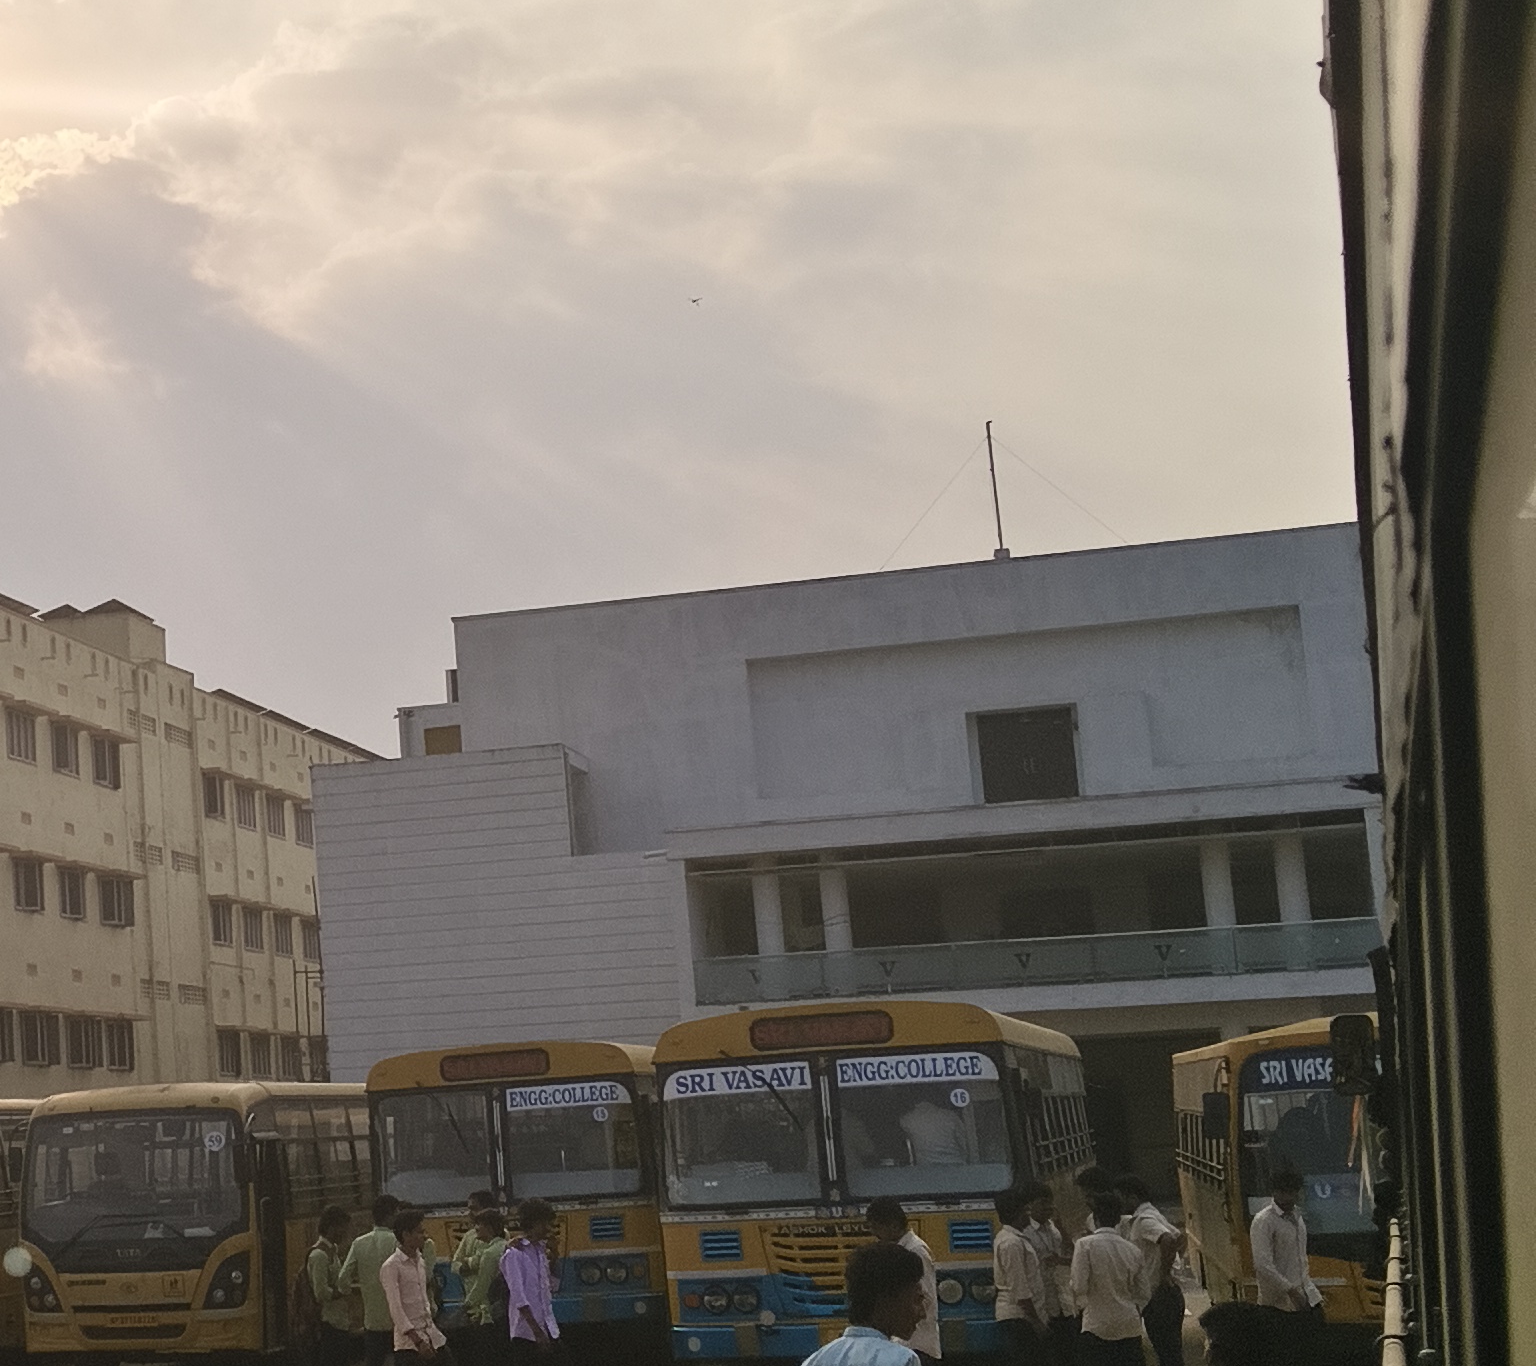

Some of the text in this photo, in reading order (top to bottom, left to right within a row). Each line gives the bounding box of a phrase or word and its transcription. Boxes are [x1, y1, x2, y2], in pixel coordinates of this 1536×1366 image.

[675, 1071, 715, 1094] SRI
[722, 1066, 807, 1090] VASAVI
[1259, 1057, 1333, 1085] SRI VASA
[953, 1091, 967, 1105] 16
[207, 1135, 223, 1149] 59
